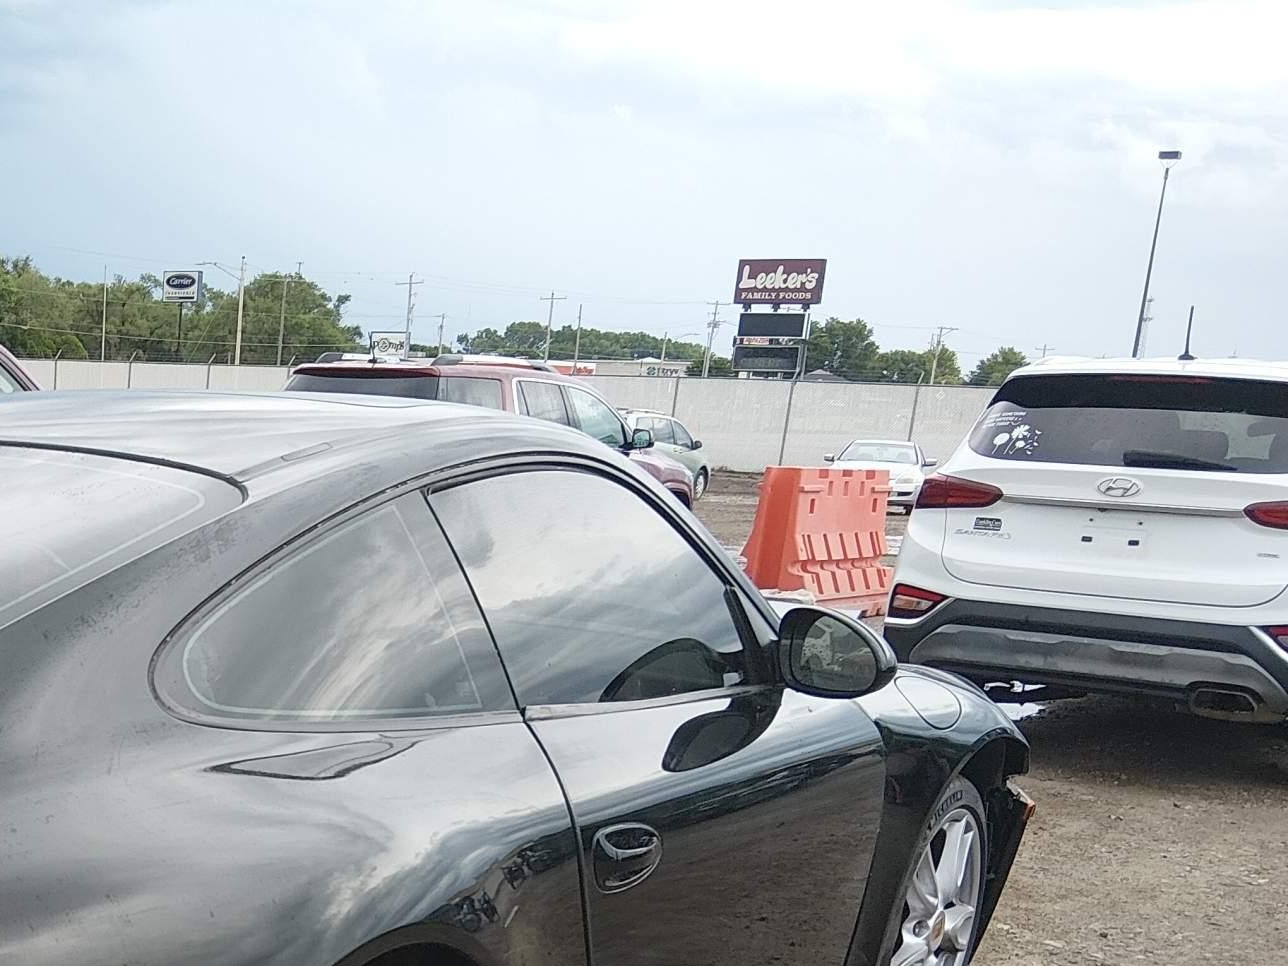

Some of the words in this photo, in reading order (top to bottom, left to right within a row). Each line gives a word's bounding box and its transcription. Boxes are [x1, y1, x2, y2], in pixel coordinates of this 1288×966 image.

[739, 265, 819, 289] Leeker's
[740, 291, 777, 299] FAMILY
[779, 291, 812, 299] FOODS
